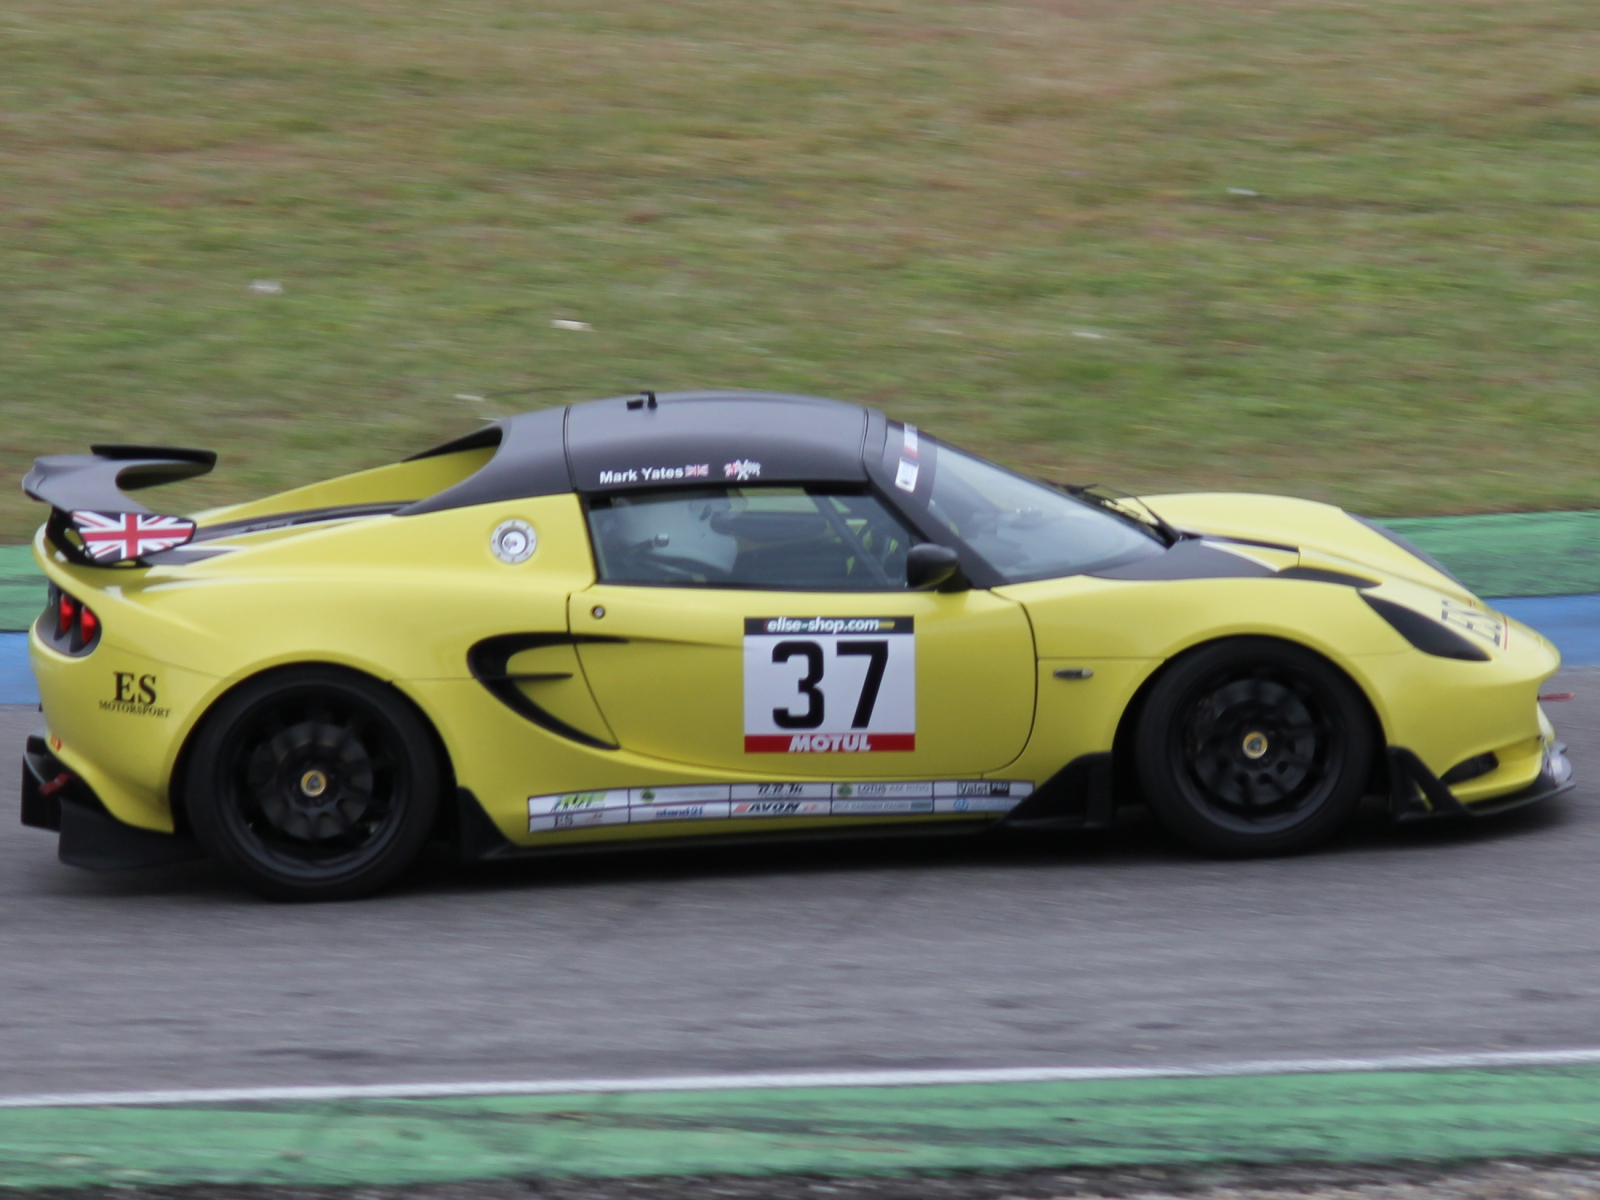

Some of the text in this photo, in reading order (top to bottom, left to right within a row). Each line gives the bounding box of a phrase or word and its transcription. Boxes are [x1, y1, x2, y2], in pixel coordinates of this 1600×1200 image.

[600, 466, 684, 485] Mark Yates
[767, 616, 880, 635] elise-shop.com
[112, 671, 157, 706] ES
[771, 640, 889, 730] 37
[99, 700, 170, 718] MOTORSPORT
[787, 733, 872, 753] MOTUL
[748, 802, 801, 813] AVON
